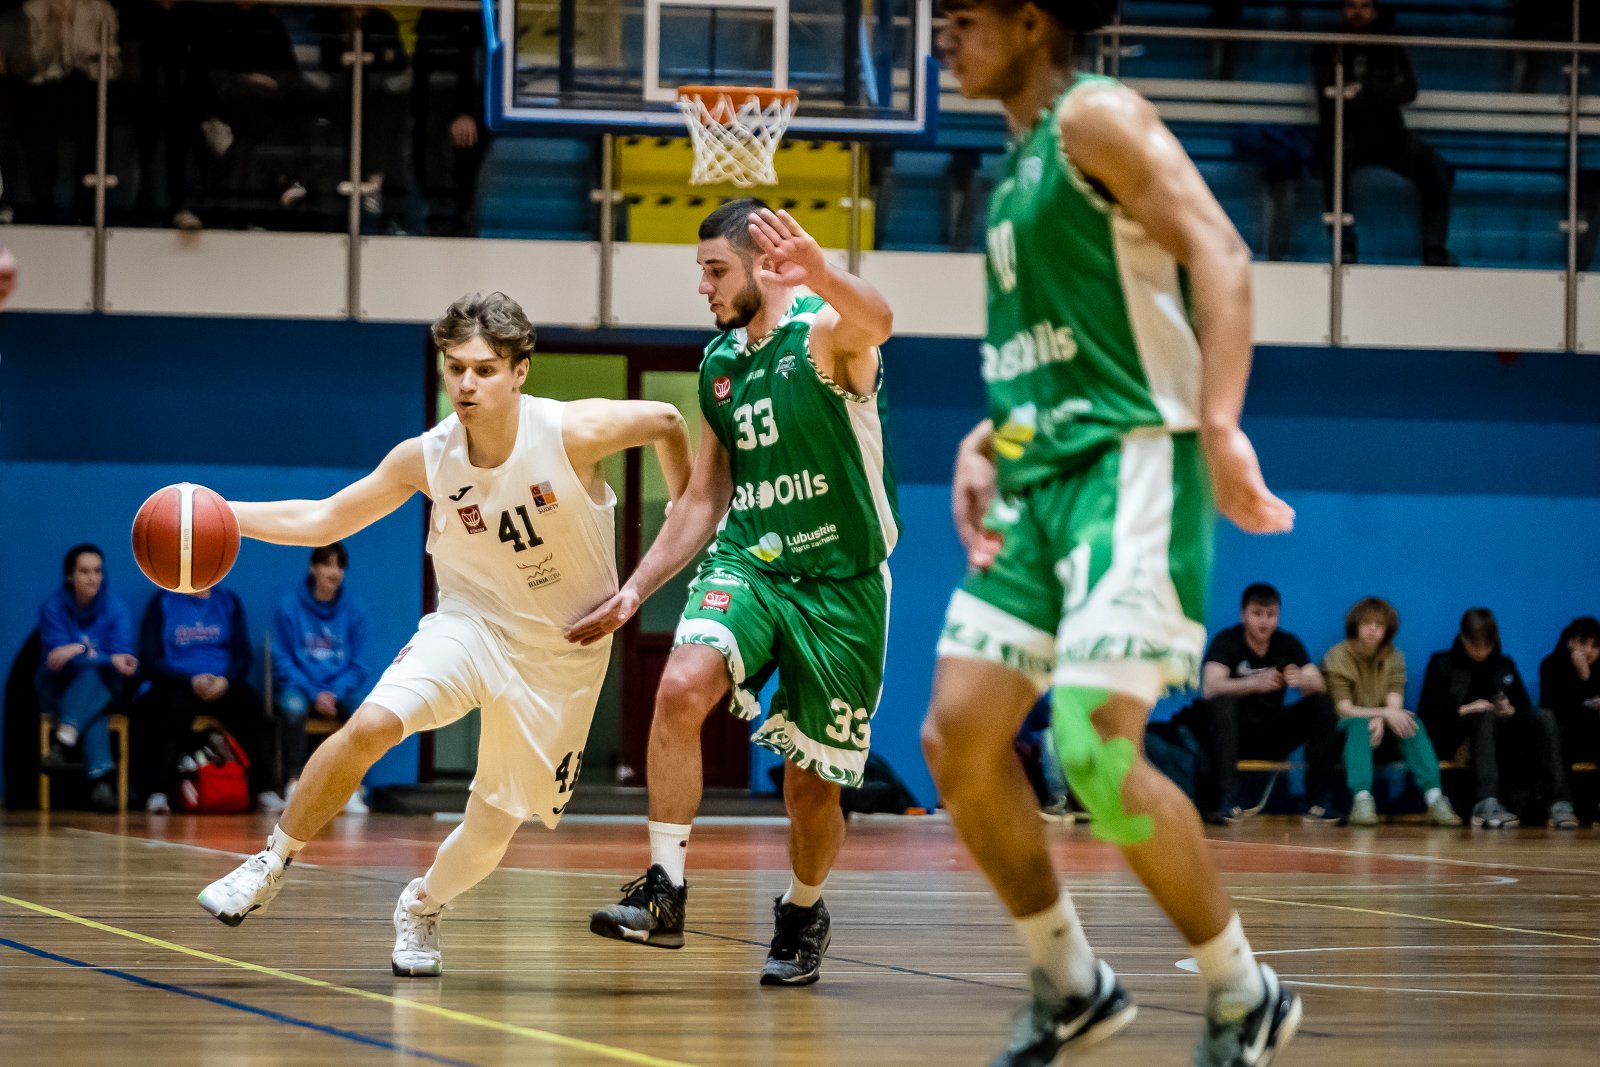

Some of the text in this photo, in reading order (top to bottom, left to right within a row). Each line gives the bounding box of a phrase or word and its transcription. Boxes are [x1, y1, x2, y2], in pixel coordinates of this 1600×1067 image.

[733, 397, 779, 450] 33
[774, 469, 829, 505] Oils
[498, 505, 544, 552] 41
[786, 522, 837, 546] Lubuskie
[826, 697, 871, 749] 33
[555, 751, 583, 793] 41
